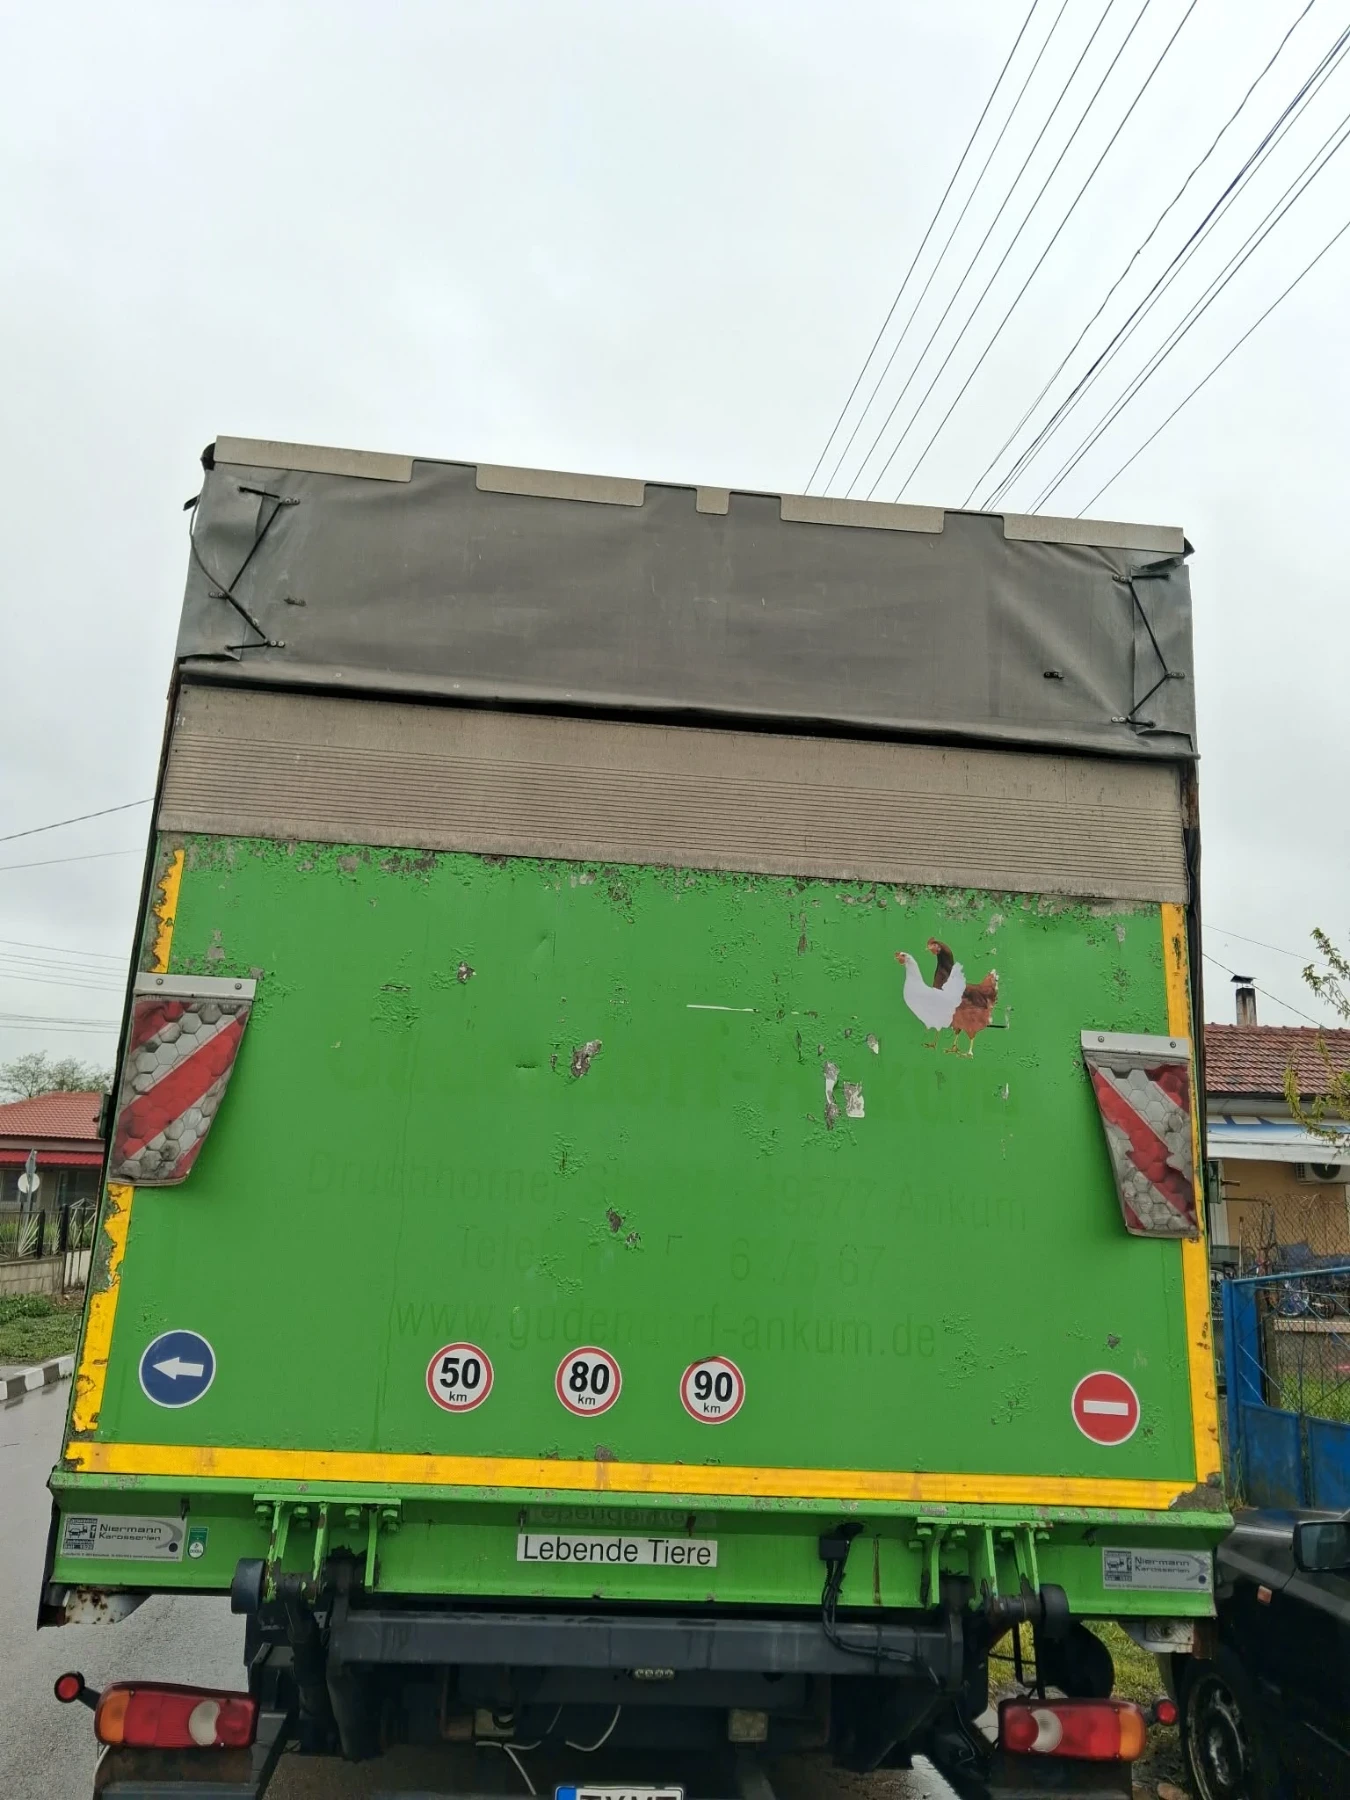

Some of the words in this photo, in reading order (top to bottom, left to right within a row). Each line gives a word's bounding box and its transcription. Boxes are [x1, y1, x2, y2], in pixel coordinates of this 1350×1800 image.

[440, 1357, 482, 1390] 50
[569, 1361, 610, 1395] 80
[694, 1370, 734, 1403] 90
[449, 1391, 467, 1403] km
[577, 1394, 596, 1406] km
[703, 1402, 721, 1414] km
[99, 1523, 162, 1534] Niermann
[98, 1532, 161, 1542] Karosserien
[523, 1535, 638, 1562] Lebende
[648, 1539, 711, 1565] Tiere
[1134, 1556, 1190, 1567] Niermann
